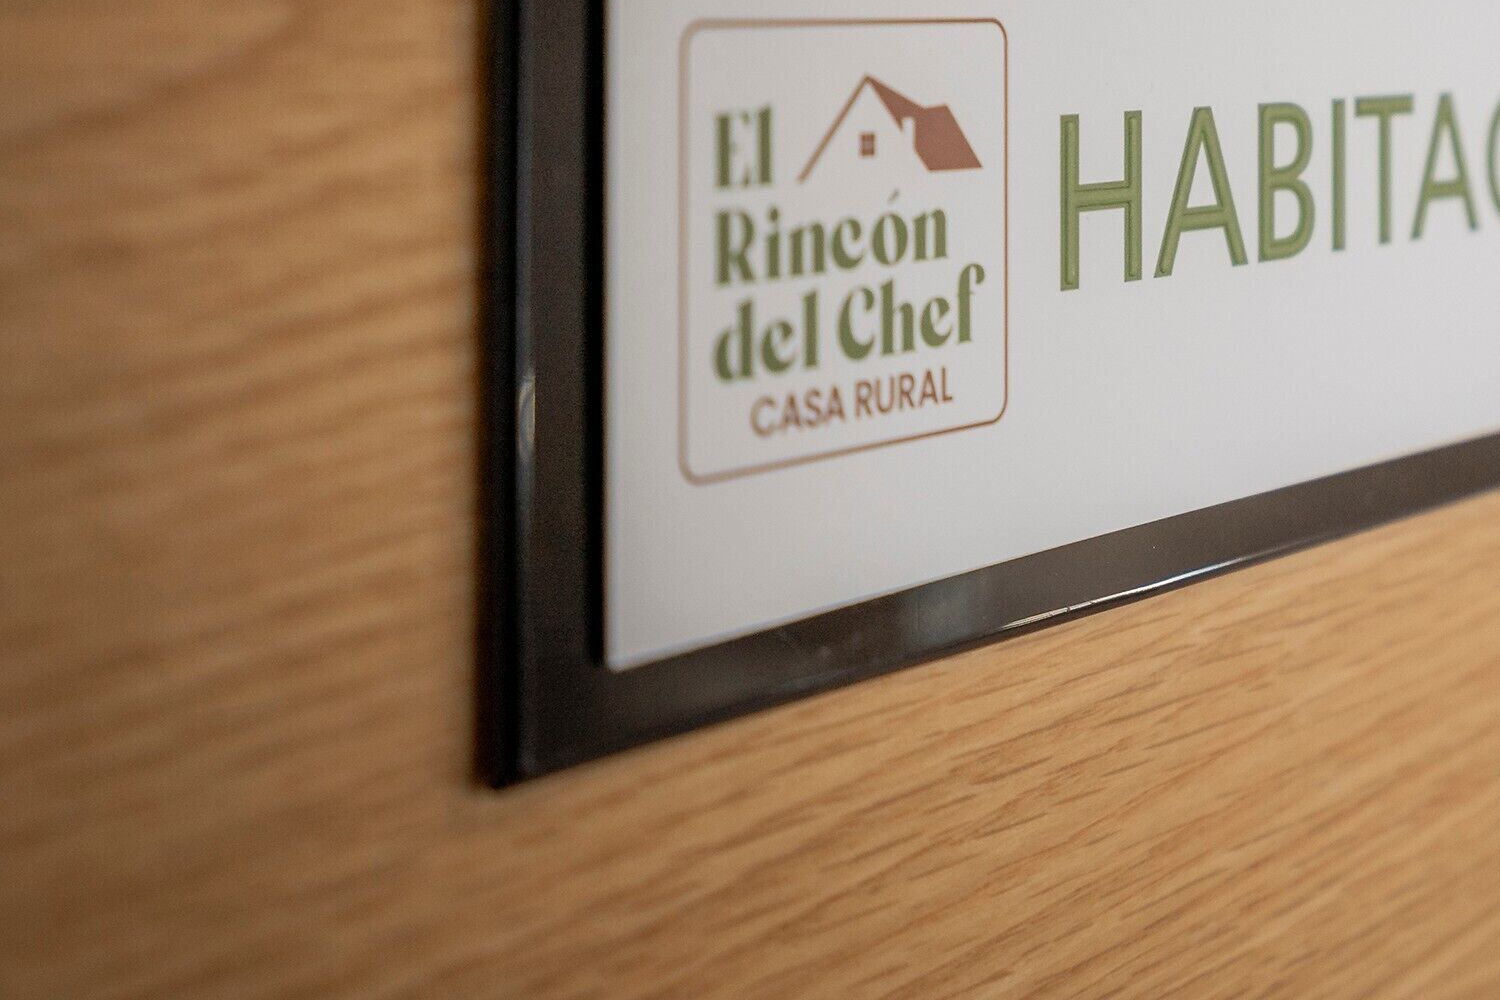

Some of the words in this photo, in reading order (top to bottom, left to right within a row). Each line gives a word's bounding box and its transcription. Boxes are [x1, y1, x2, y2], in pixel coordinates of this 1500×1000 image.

[714, 104, 773, 190] El
[714, 189, 948, 287] Rincón
[712, 289, 819, 383] del
[837, 263, 985, 361] Chef
[750, 386, 846, 437] CASA
[855, 367, 953, 420] RURAL
